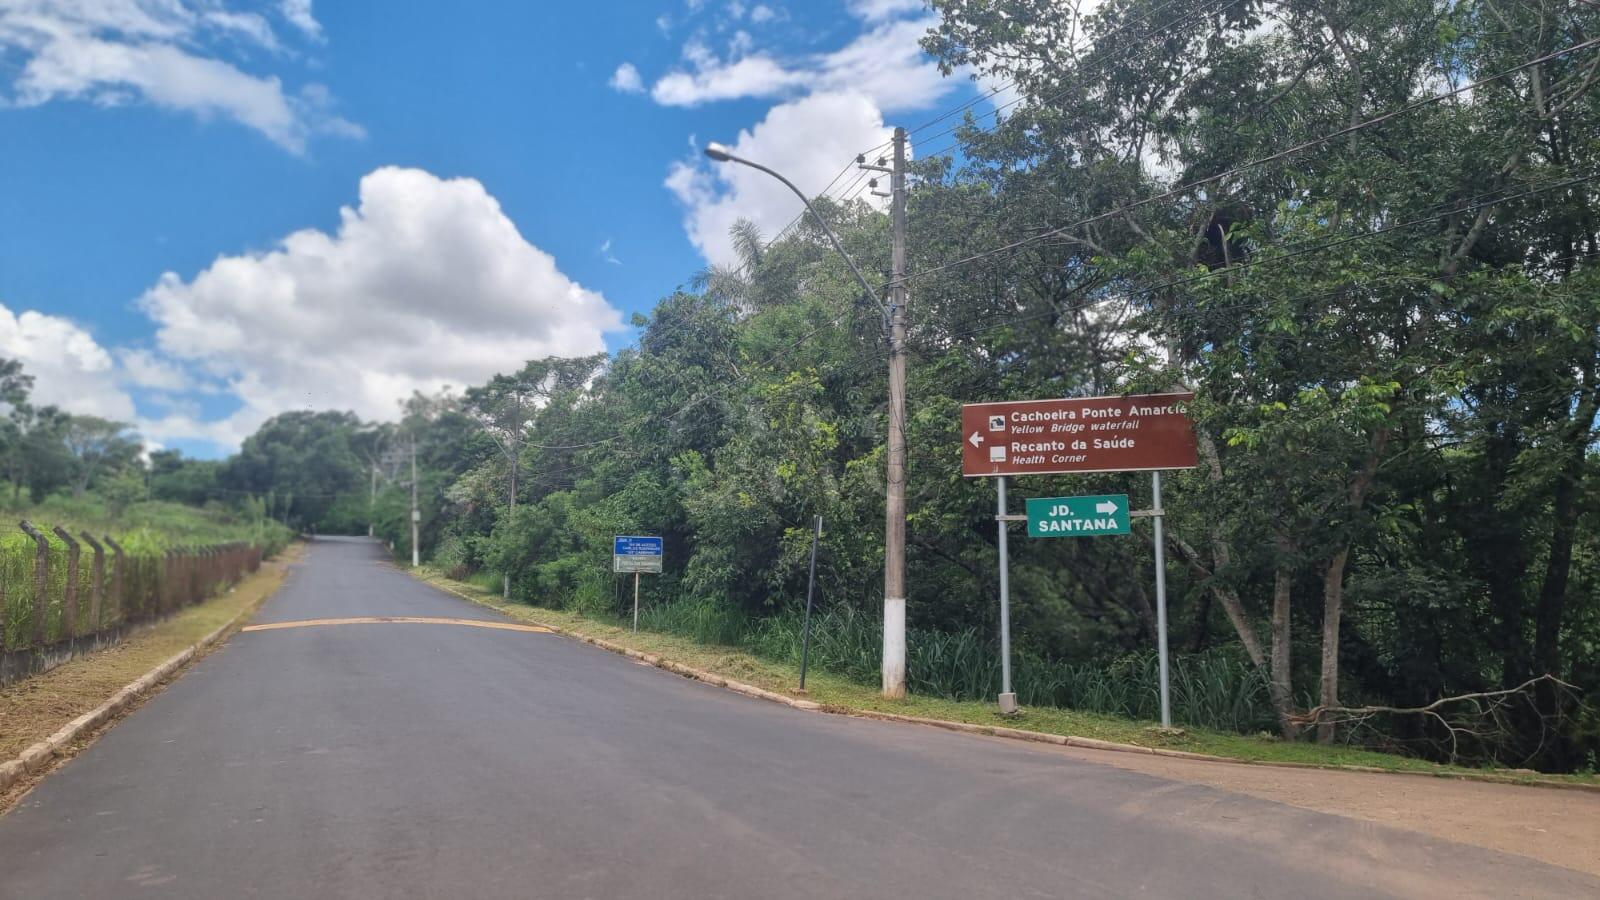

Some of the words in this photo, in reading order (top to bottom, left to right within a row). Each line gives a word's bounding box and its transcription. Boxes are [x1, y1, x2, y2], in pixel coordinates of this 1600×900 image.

[1011, 409, 1076, 422] Cachoeira
[1082, 406, 1121, 419] Ponte
[1011, 424, 1044, 434] Yellow
[1051, 423, 1085, 433] Bridge
[1091, 420, 1139, 431] waterfall
[1012, 441, 1065, 453] Recanto
[1071, 440, 1087, 450] da
[1093, 435, 1135, 449] Saúde
[1012, 455, 1045, 465] Health
[1051, 454, 1087, 464] Corner
[1048, 504, 1075, 517] JD.
[1038, 518, 1118, 532] SANTANA
